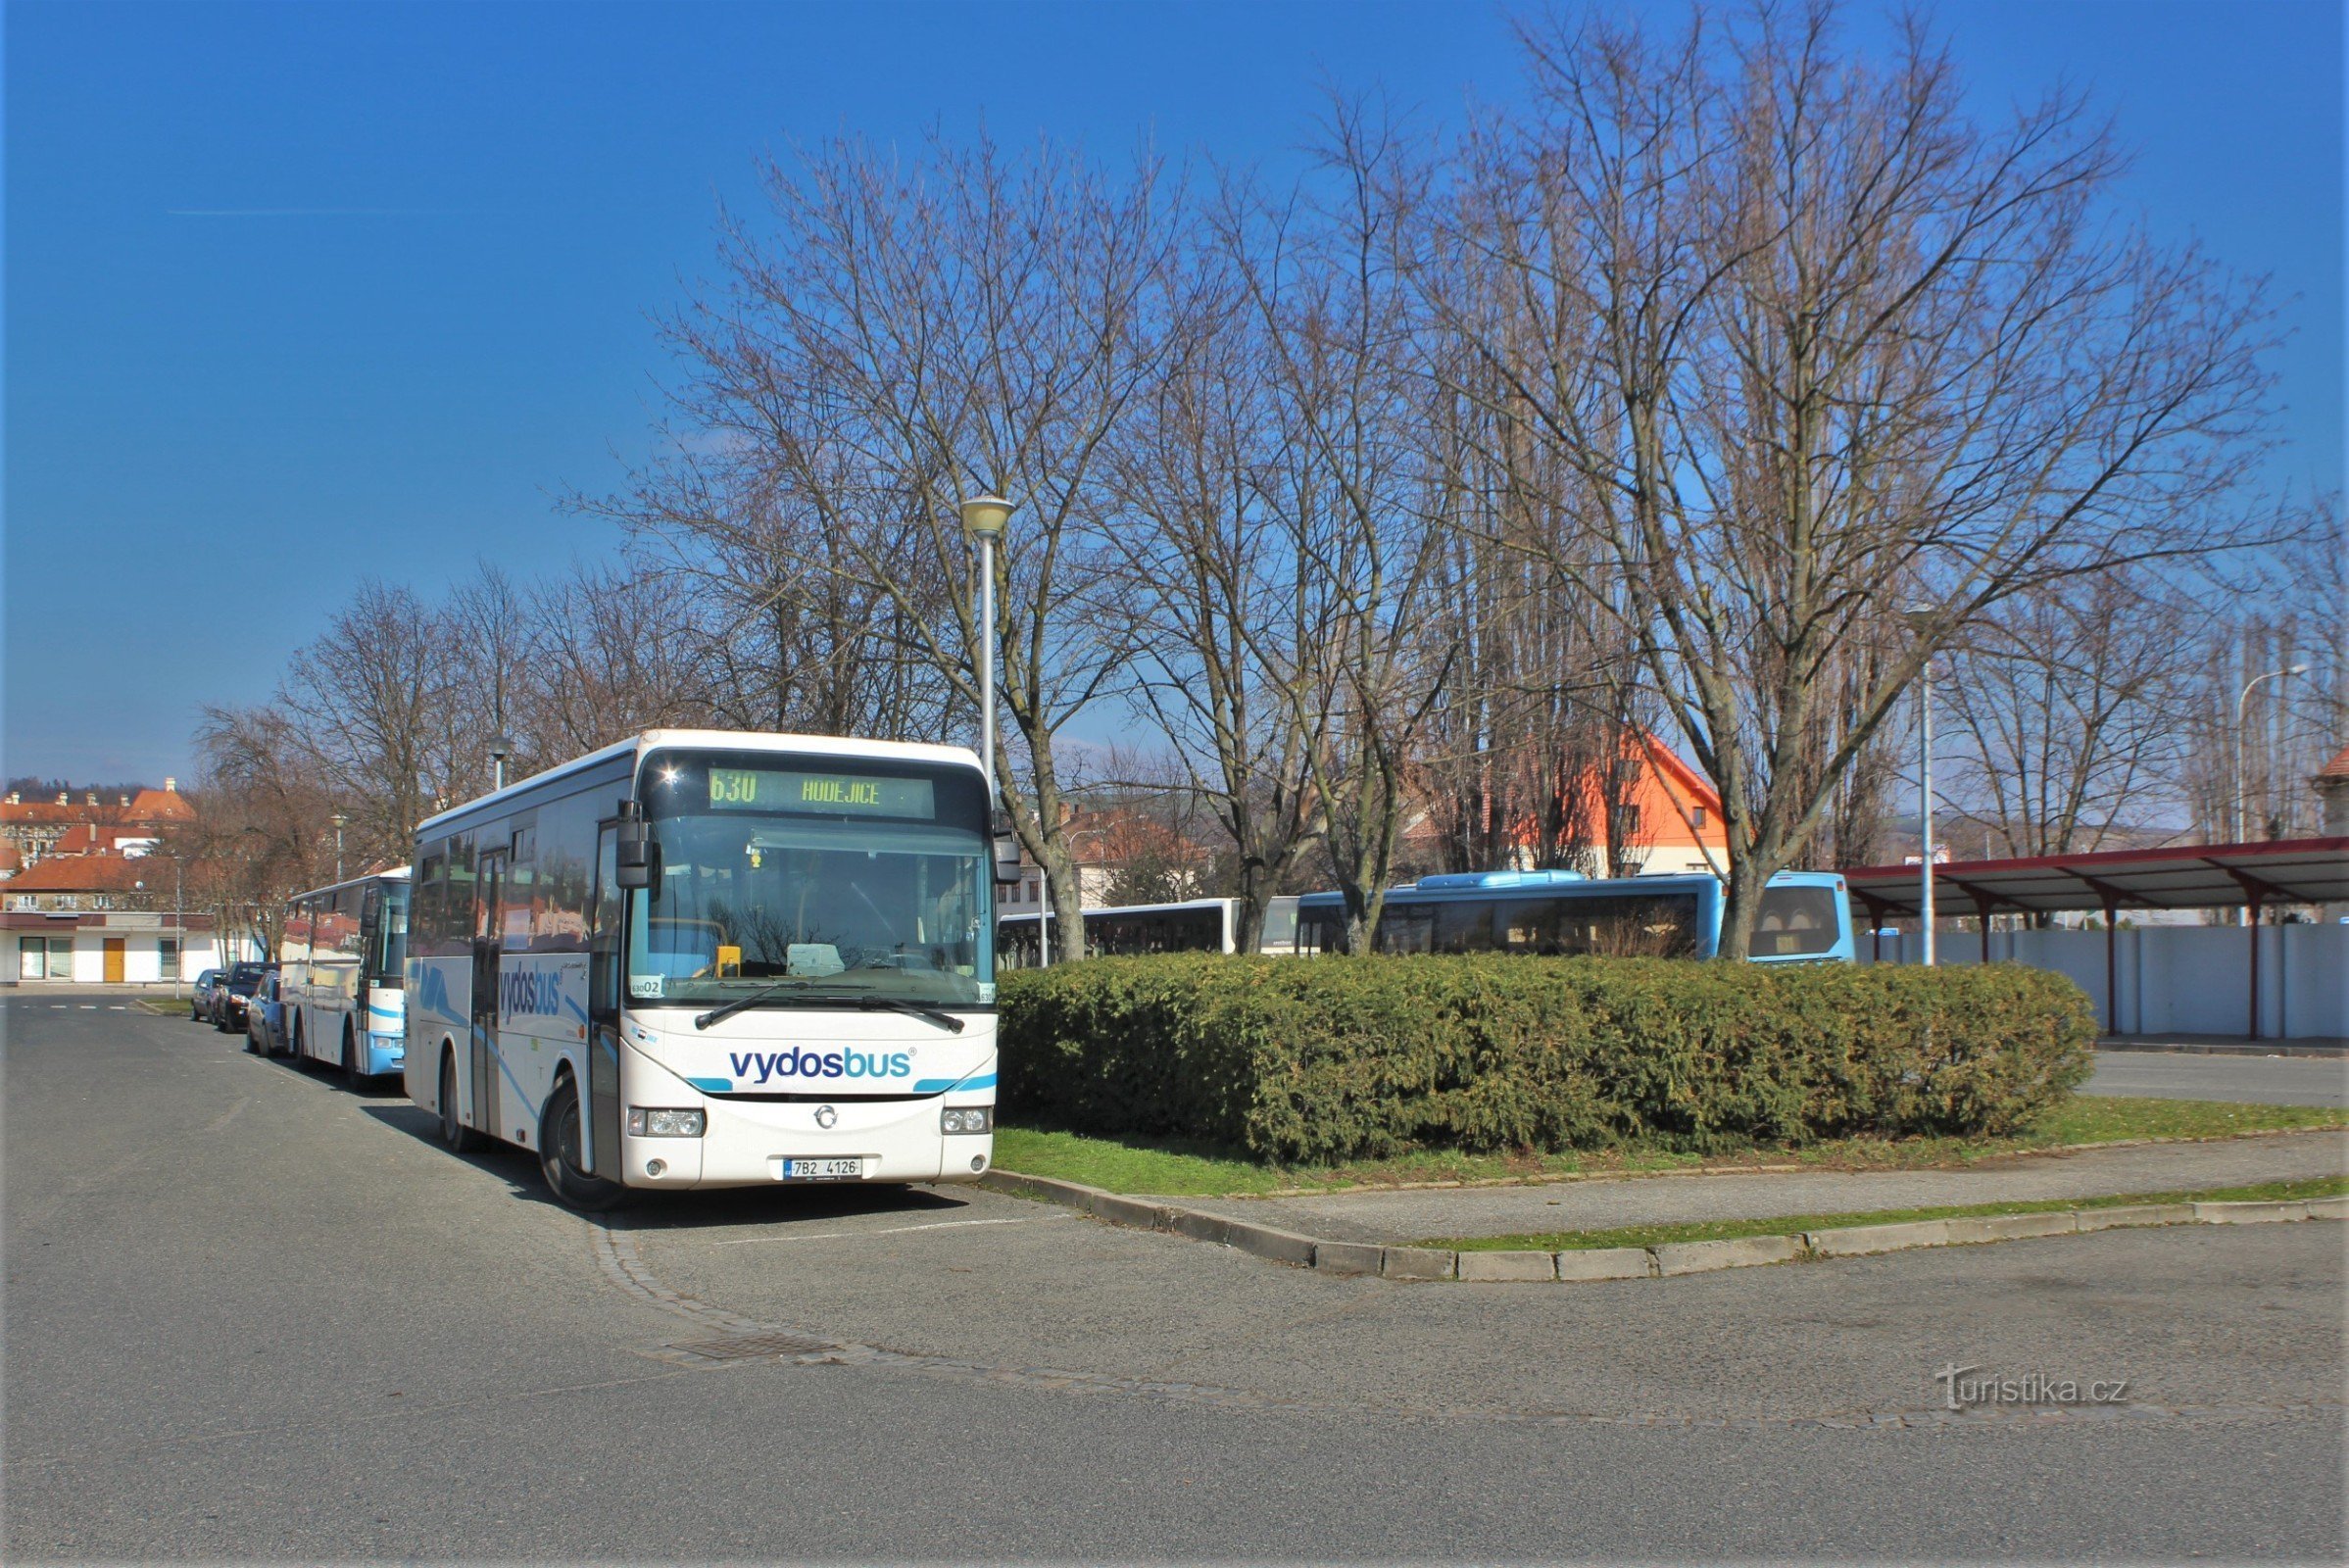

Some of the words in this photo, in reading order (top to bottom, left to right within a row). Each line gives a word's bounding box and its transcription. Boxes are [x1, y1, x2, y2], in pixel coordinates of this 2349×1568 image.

[710, 769, 756, 803] 630
[500, 960, 559, 1025] vydosbus
[795, 1161, 817, 1175] 7B2
[826, 1160, 856, 1175] 4126
